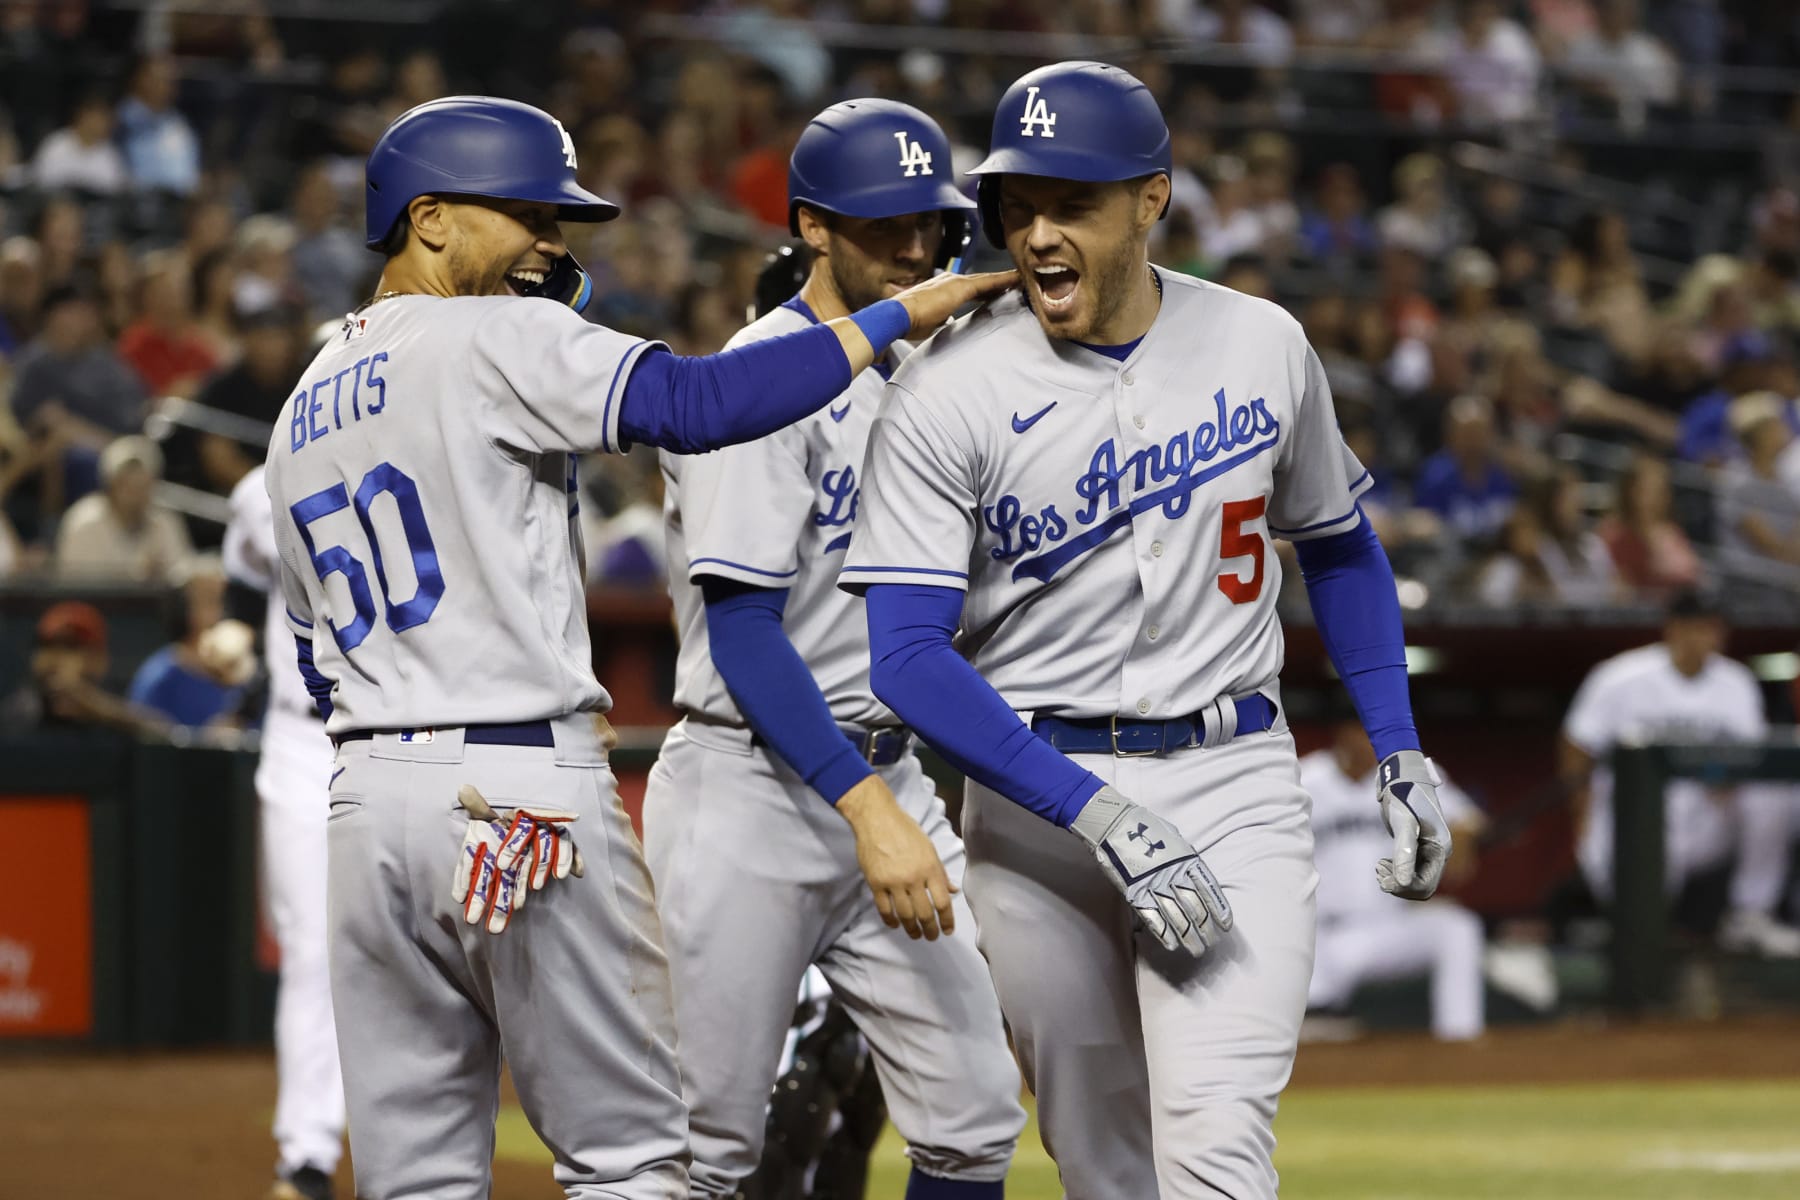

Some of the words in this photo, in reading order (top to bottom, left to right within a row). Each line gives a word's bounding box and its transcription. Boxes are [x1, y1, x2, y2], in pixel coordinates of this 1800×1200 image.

[894, 131, 934, 177] LA
[1020, 86, 1056, 138] LA
[291, 352, 388, 454] BETTS
[984, 495, 1068, 560] Los
[1076, 387, 1280, 524] Angeles
[290, 462, 446, 655] 50
[1217, 495, 1266, 605] 5
